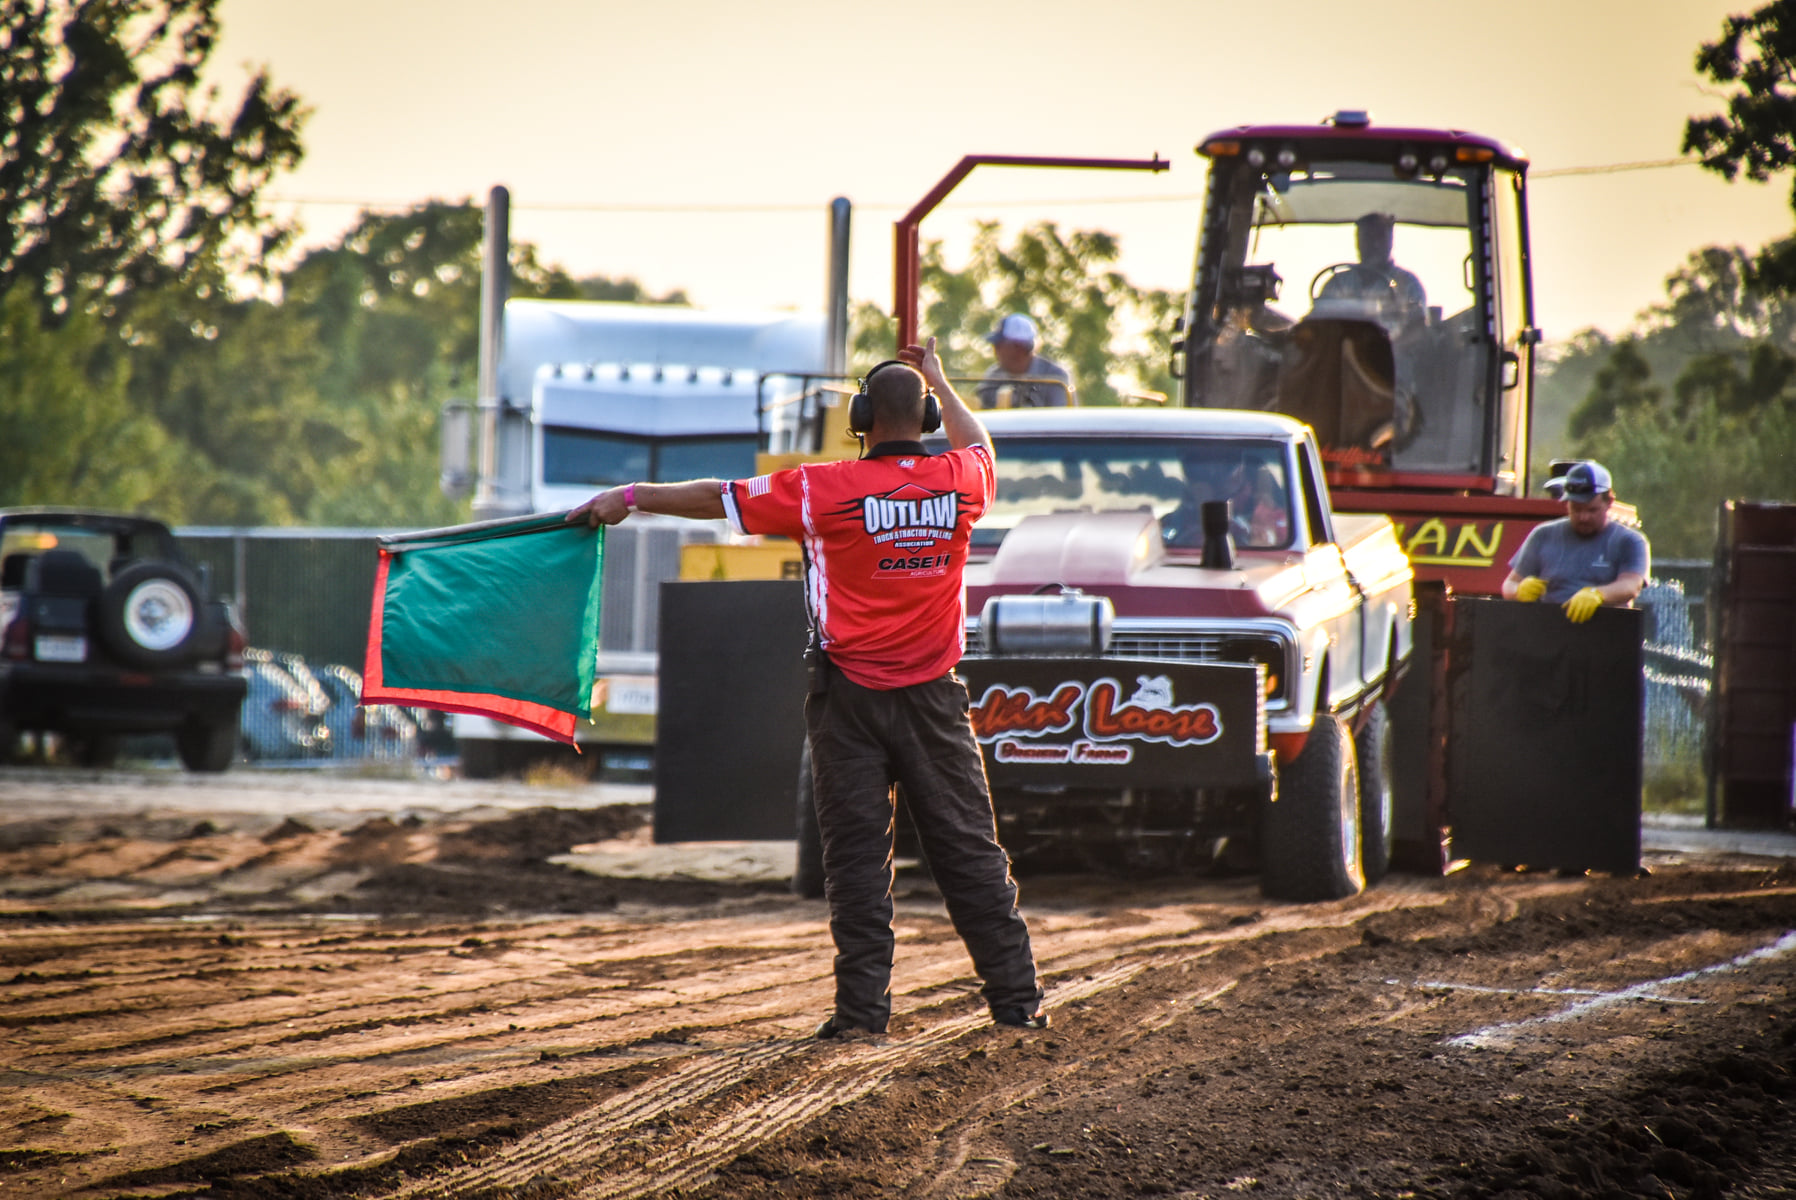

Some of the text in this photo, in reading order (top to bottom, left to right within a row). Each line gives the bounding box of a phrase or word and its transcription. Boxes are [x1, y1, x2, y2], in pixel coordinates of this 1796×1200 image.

[864, 490, 957, 534] OUTLAW
[873, 533, 894, 545] TRUCK
[898, 529, 927, 539] TRACTOR
[928, 529, 953, 541] PULLING
[878, 555, 934, 570] CASE
[1087, 680, 1220, 743] Loose
